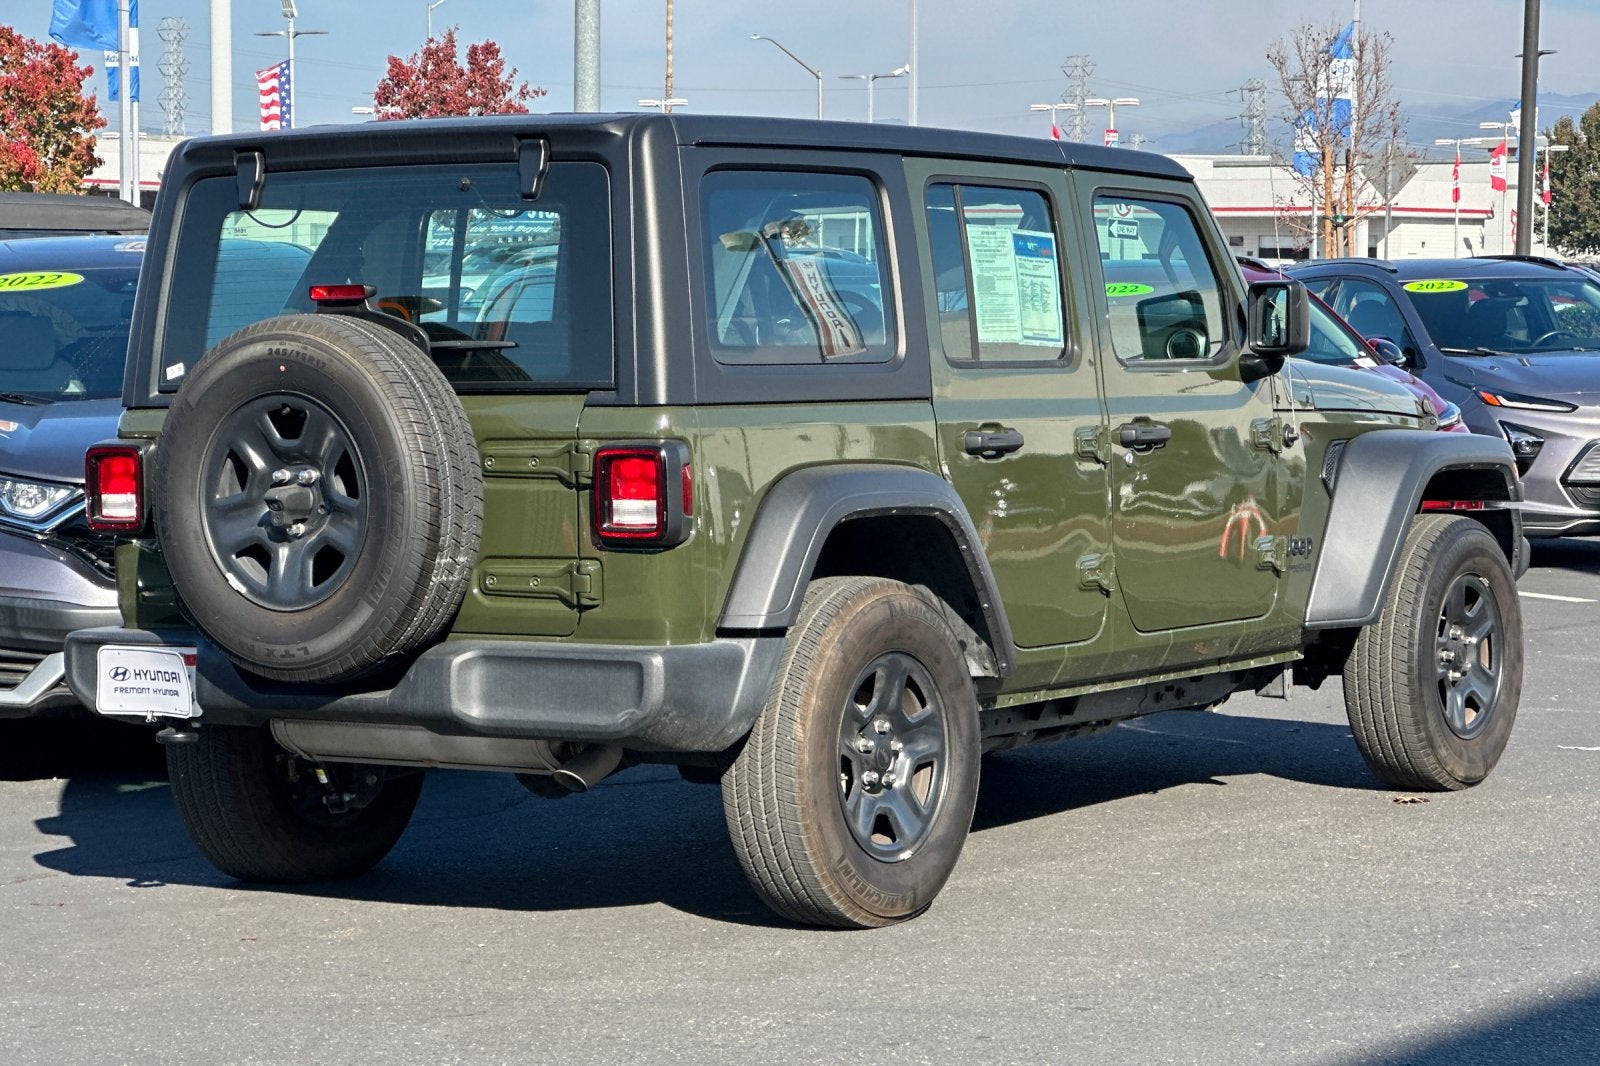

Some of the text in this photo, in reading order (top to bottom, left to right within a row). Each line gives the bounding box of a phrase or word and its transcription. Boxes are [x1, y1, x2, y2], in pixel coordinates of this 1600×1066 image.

[1116, 225, 1136, 235] ONE WAY
[0, 274, 62, 287] 2022
[1415, 281, 1455, 291] 2022
[807, 271, 851, 348] HYUNDAI
[133, 668, 182, 684] HYUNDAI
[113, 686, 180, 697] FREMONT HYUNDAI
